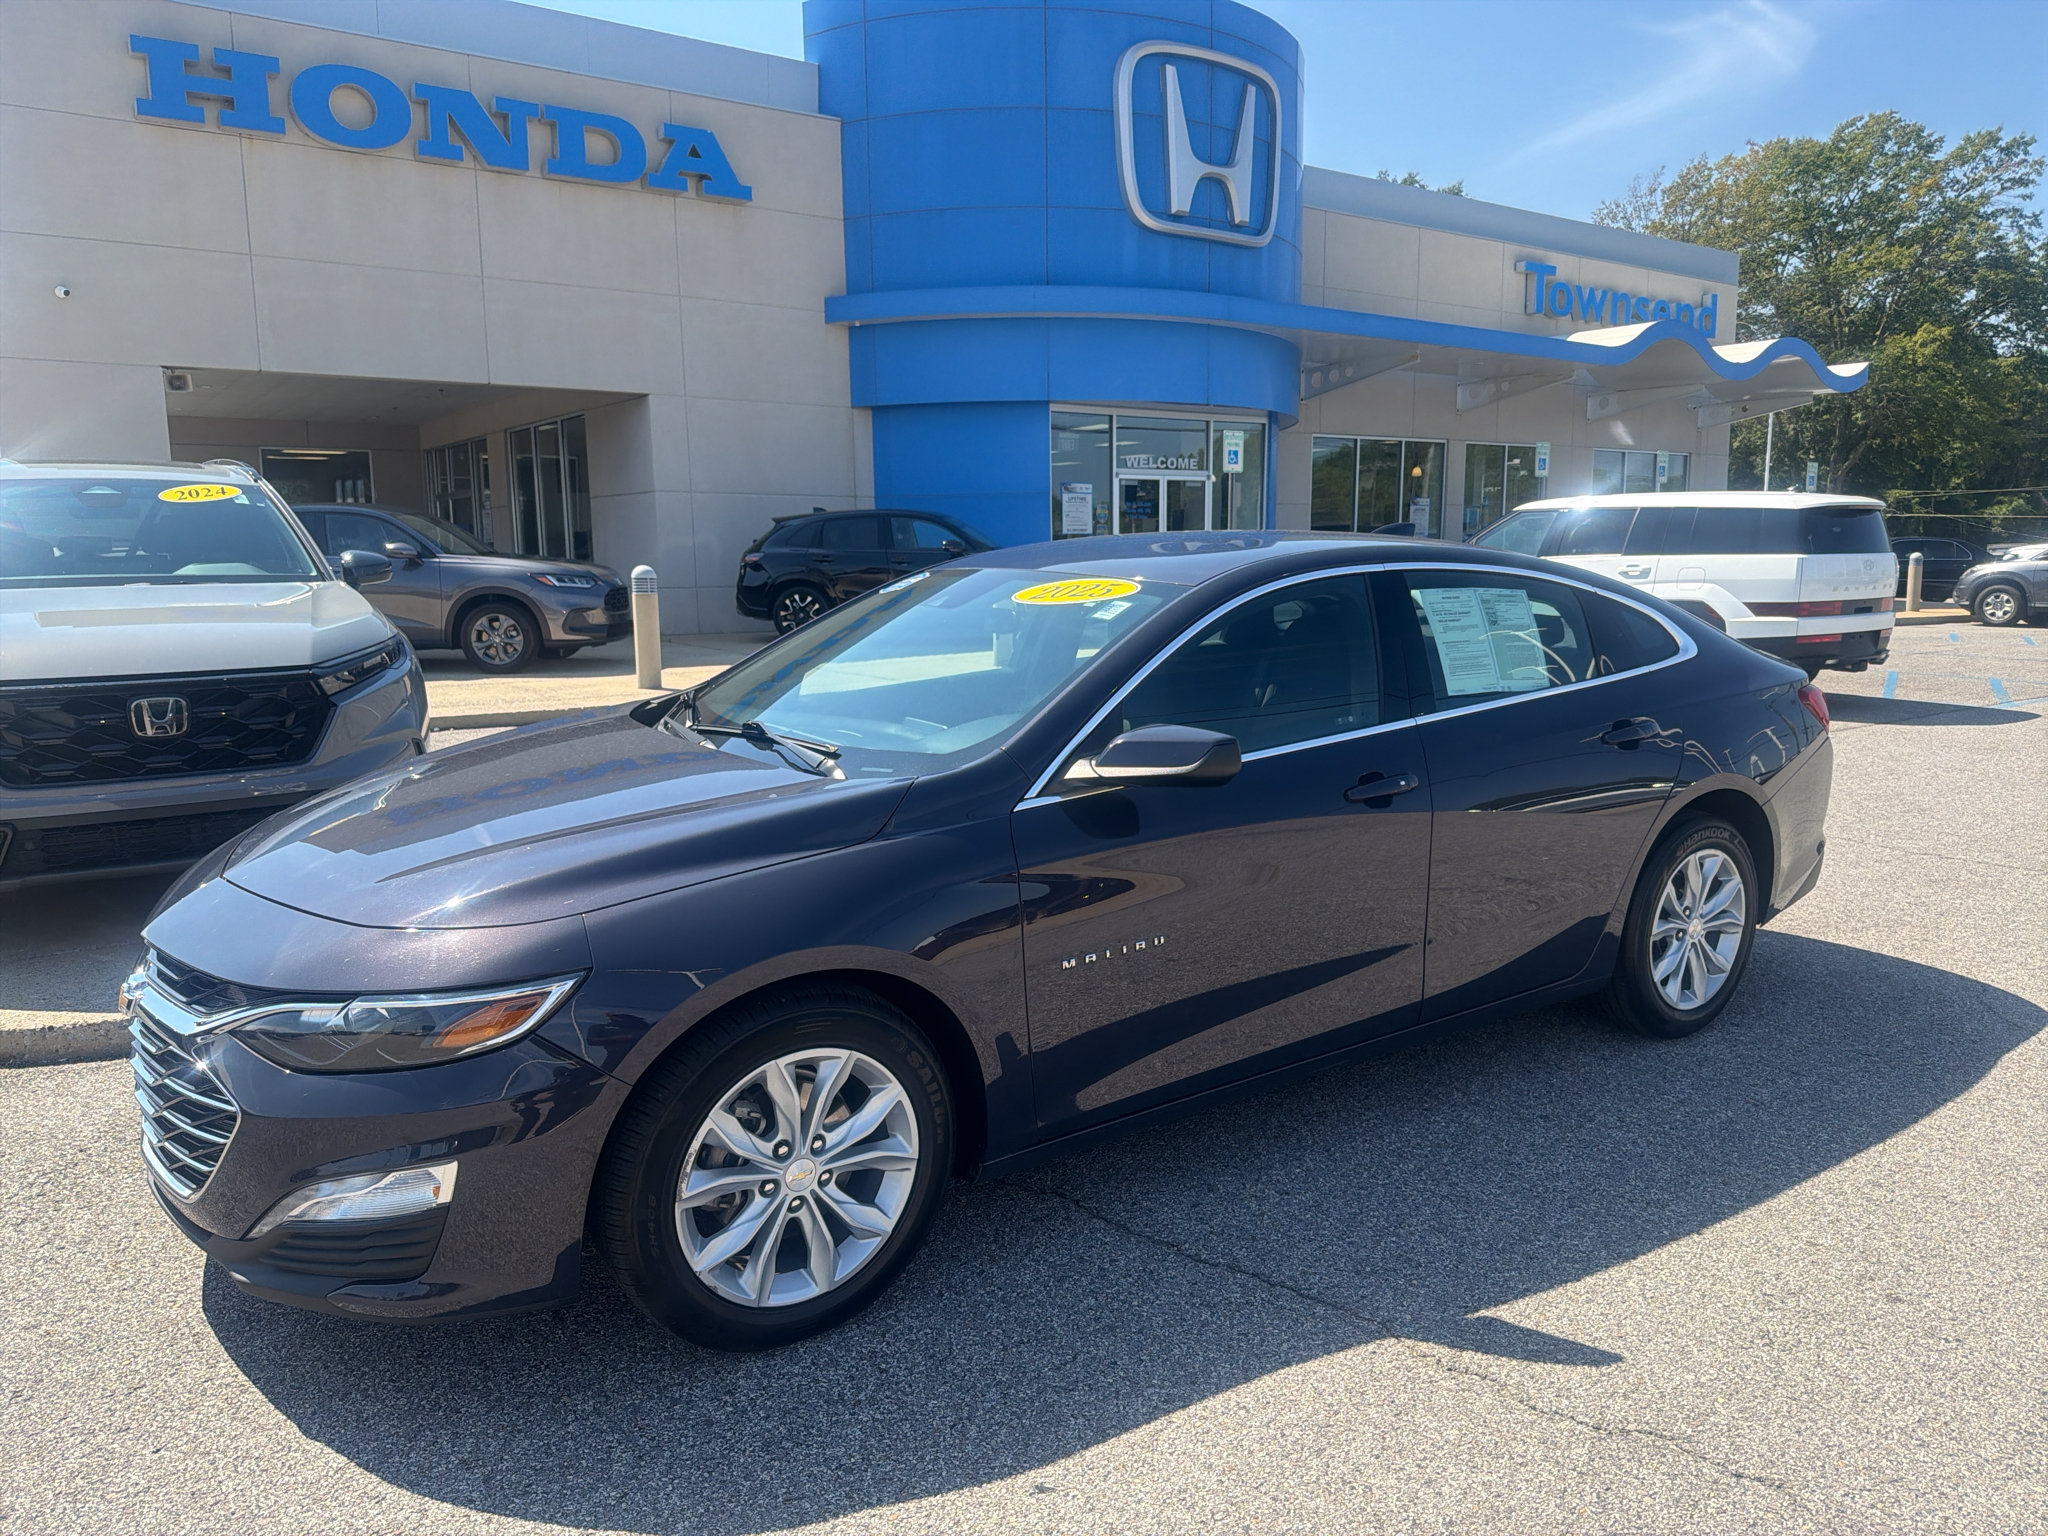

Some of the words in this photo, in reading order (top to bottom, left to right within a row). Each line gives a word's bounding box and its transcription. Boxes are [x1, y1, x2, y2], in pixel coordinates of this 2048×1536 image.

[129, 34, 753, 203] HONDA
[1516, 260, 1719, 339] Townsend
[1126, 456, 1199, 470] WELCOME
[174, 486, 228, 501] 2024
[1029, 583, 1123, 600] 2025
[1062, 936, 1165, 970] MALIBU
[906, 1050, 946, 1145] SAILUN
